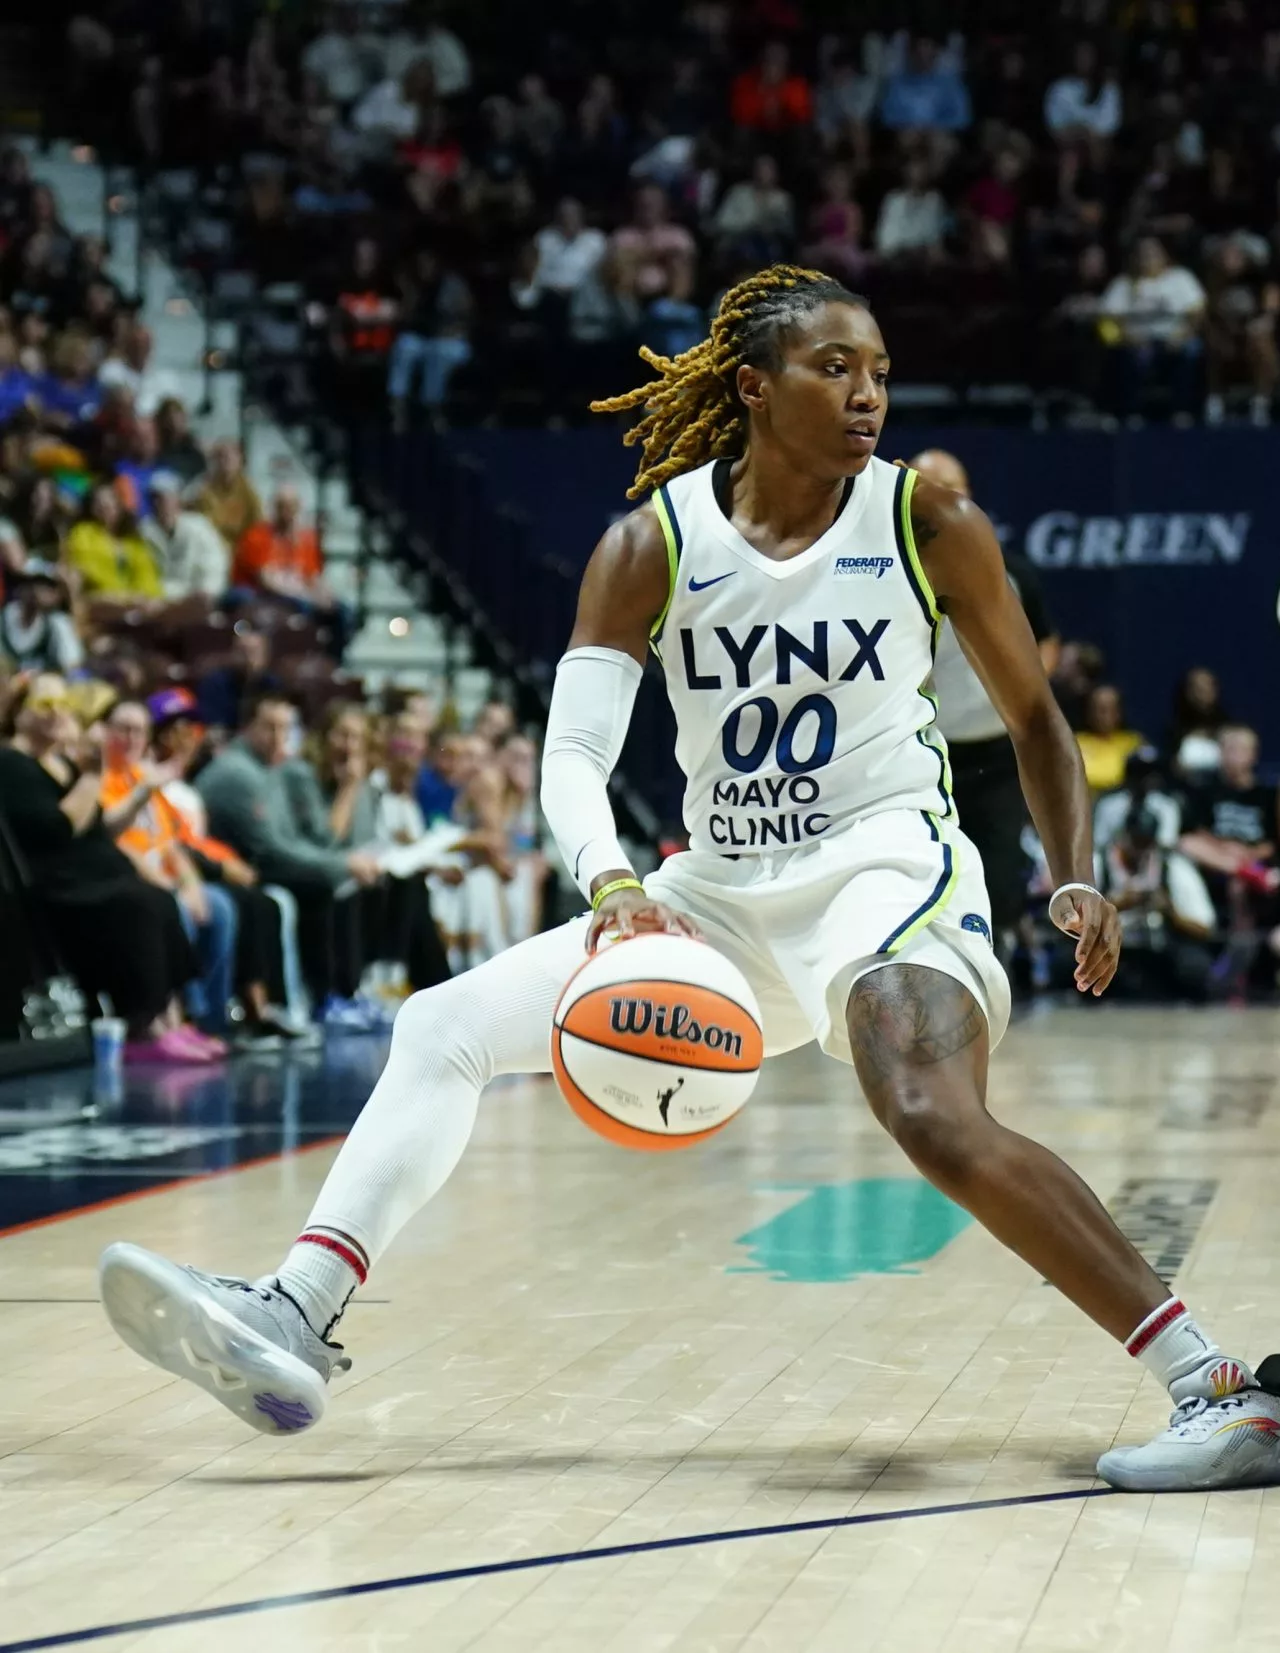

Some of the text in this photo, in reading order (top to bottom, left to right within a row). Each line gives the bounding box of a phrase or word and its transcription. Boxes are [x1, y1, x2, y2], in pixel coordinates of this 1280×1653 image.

[1025, 510, 1250, 568] GREEN
[834, 567, 876, 576] INSURANCE
[835, 557, 894, 568] FEDERATED
[679, 618, 892, 690] LYNX
[721, 693, 838, 774] 00
[712, 775, 820, 808] MAYO
[708, 812, 832, 846] CLINIC
[609, 998, 742, 1059] Wilson
